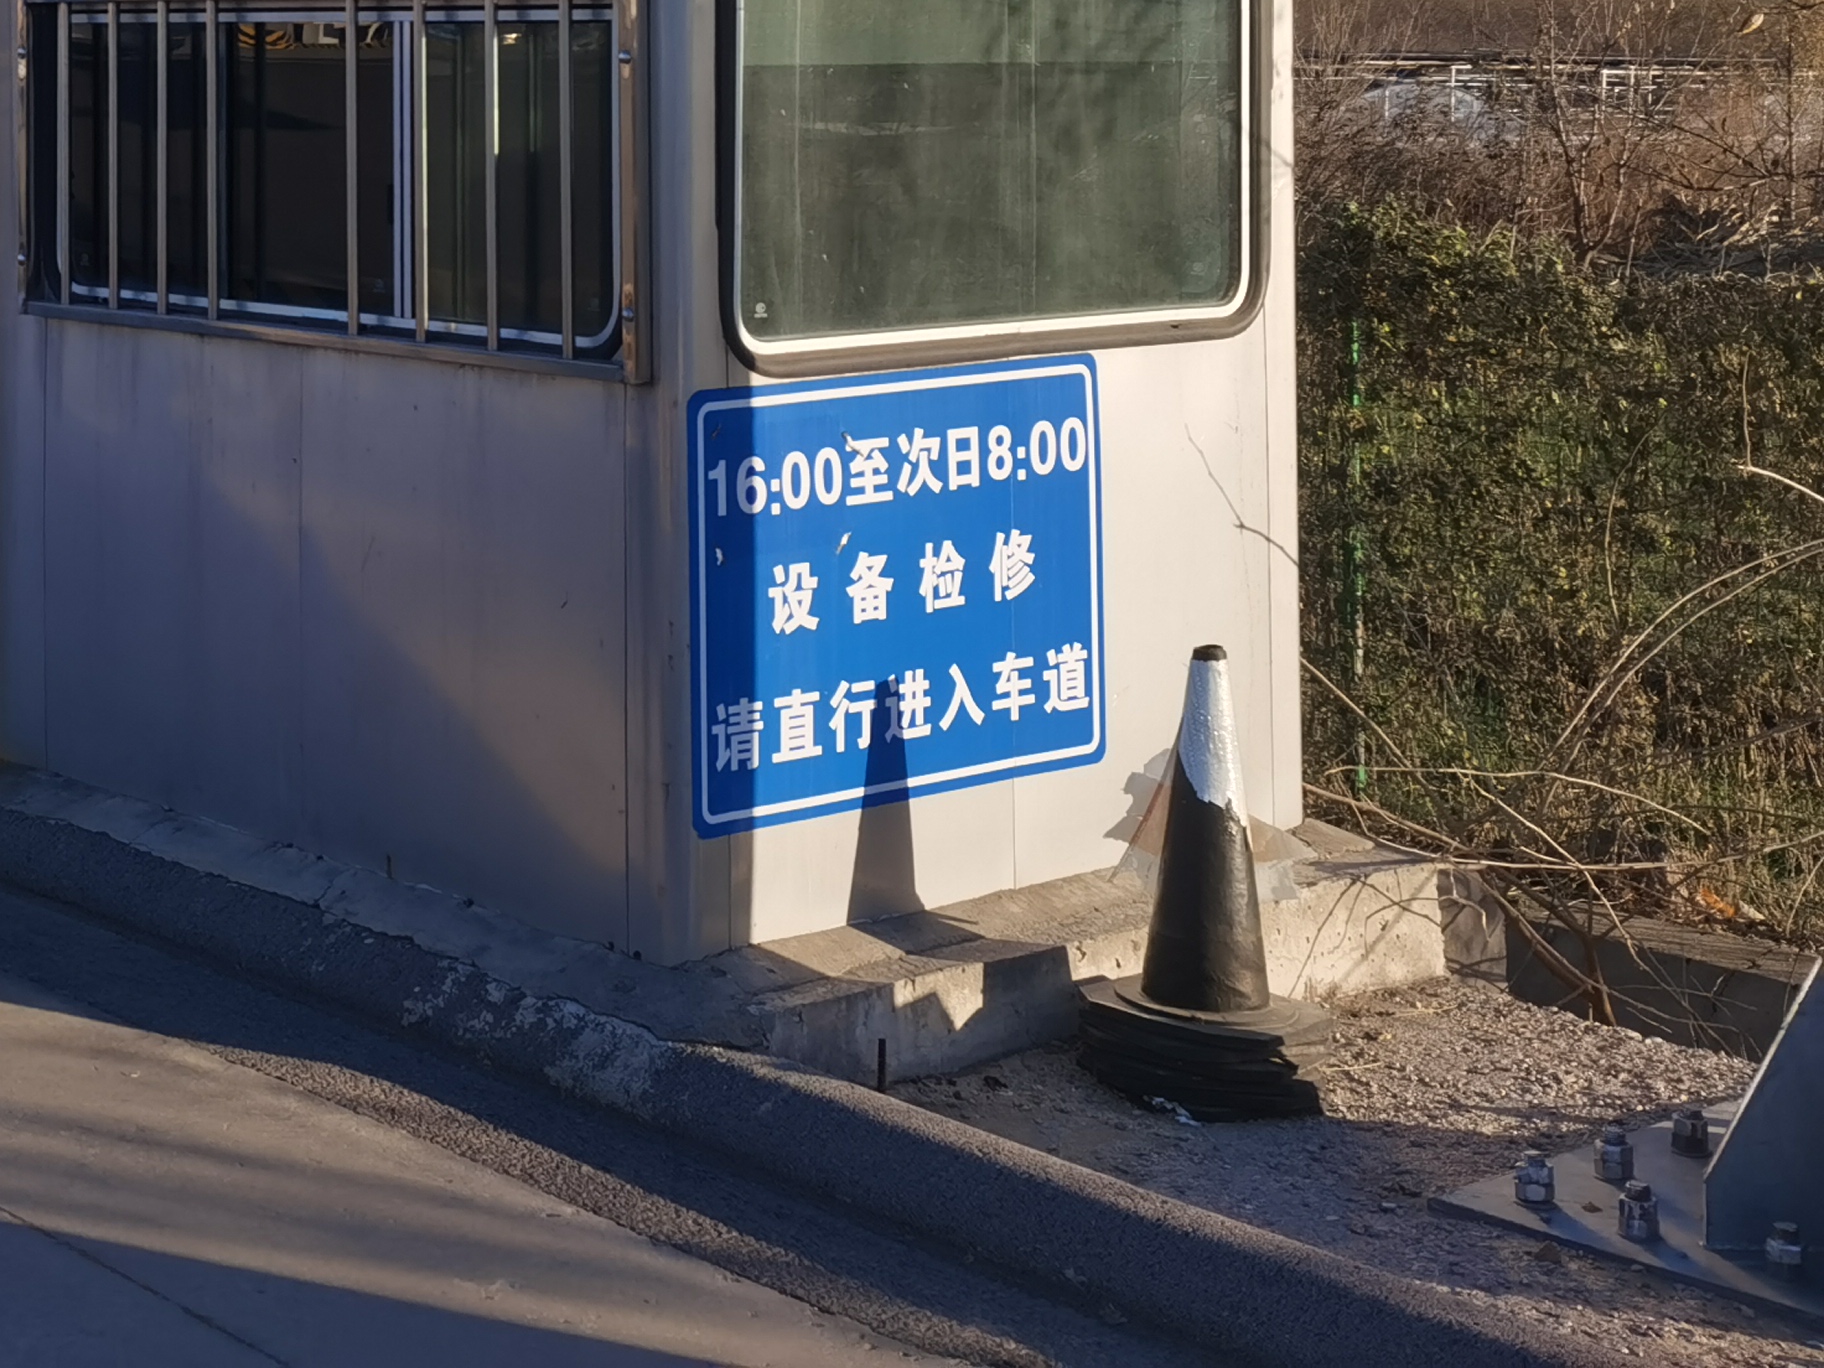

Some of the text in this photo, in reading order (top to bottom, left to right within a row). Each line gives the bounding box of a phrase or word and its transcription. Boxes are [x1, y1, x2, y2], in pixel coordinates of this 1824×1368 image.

[708, 417, 1086, 516] 16:00至次日8:00
[768, 529, 1036, 635] 设备检修
[711, 642, 1090, 772] 请直行进入车道
